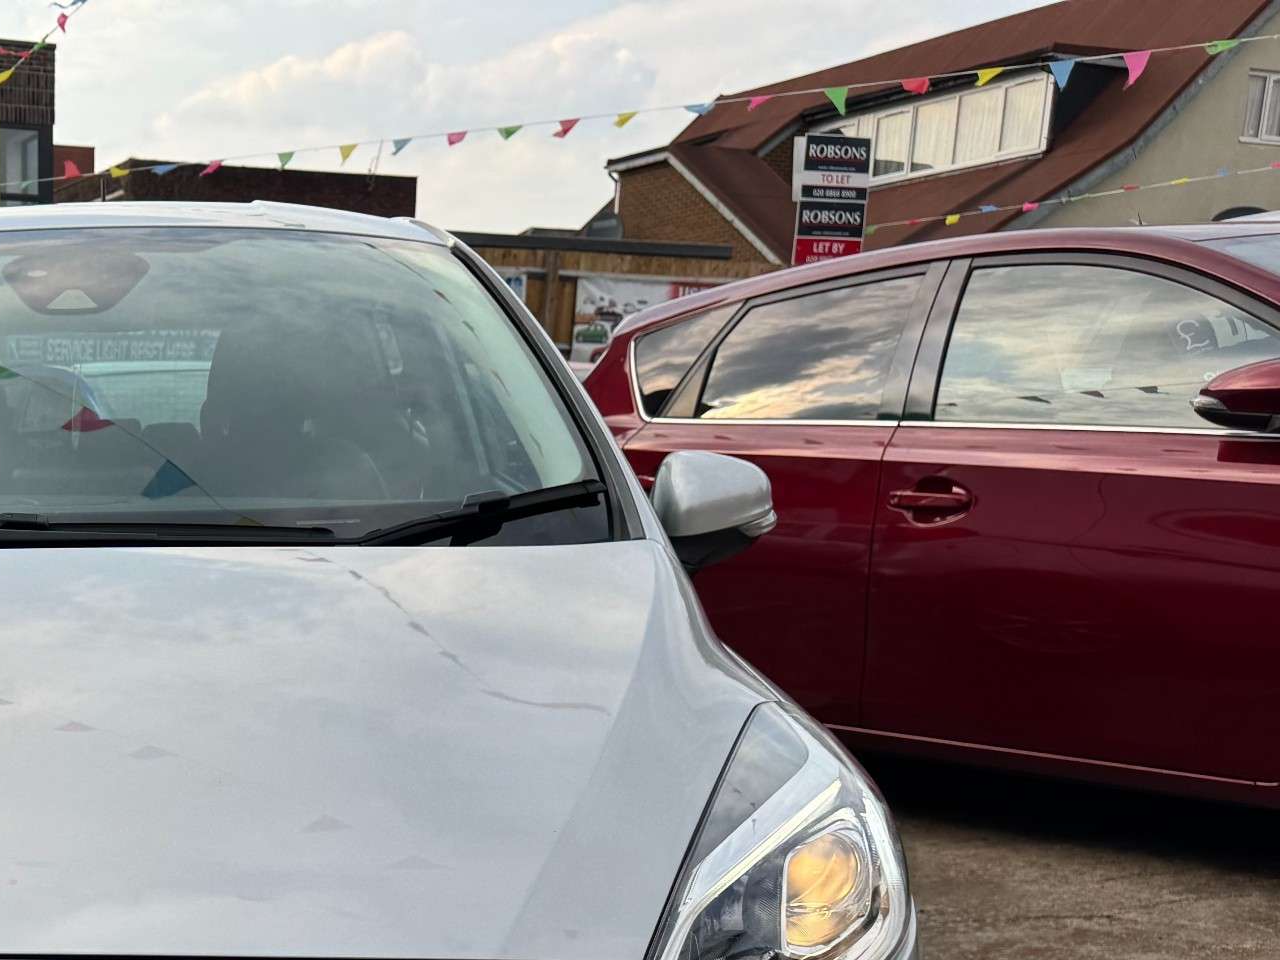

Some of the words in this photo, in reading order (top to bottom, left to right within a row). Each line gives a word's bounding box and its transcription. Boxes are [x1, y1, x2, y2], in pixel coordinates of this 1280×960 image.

[808, 143, 867, 160] ROBSONS
[821, 173, 833, 184] TO
[835, 174, 851, 185] LET
[802, 209, 862, 226] ROBSONS
[812, 242, 831, 254] LET
[832, 242, 846, 255] BY
